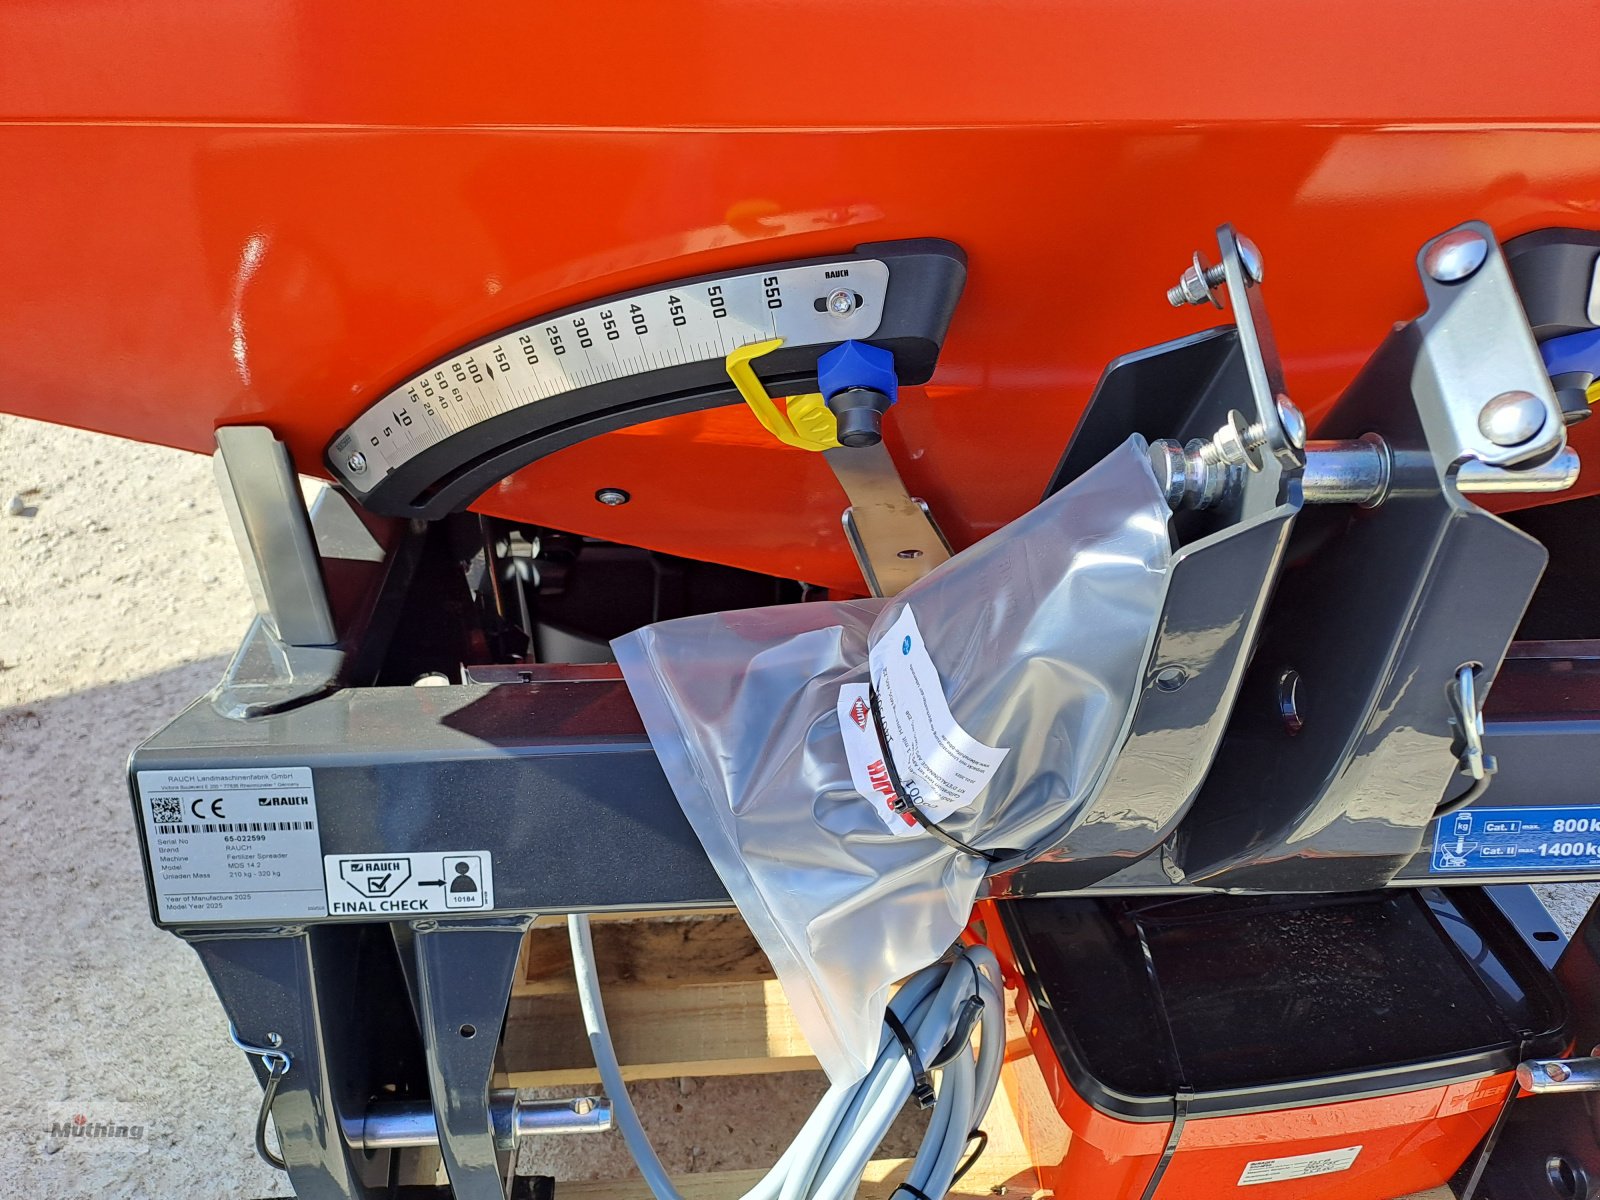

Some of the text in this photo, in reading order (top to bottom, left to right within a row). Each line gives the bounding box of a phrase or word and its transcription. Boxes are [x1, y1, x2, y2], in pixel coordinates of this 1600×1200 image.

[825, 269, 849, 279] RAUCH
[763, 275, 783, 310] 550
[667, 294, 687, 327] 450
[707, 285, 727, 319] 500
[599, 309, 620, 341] 350
[629, 303, 649, 336] 400
[545, 325, 566, 356] 250
[572, 317, 593, 349] 300
[492, 344, 511, 373] 150
[518, 334, 539, 366] 200
[451, 362, 467, 383] 80
[464, 356, 484, 384] 100
[419, 379, 435, 398] 30
[434, 371, 449, 391] 50
[406, 387, 420, 404] 15
[438, 395, 449, 410] 40
[451, 388, 464, 403] 60
[398, 407, 413, 427] 10
[423, 402, 435, 417] 20
[382, 426, 393, 438] 5
[370, 436, 380, 447] 0
[856, 701, 866, 727] KUHN
[168, 775, 195, 783] RAUCH
[272, 796, 309, 806] RAUCH
[1457, 822, 1470, 832] kg
[1486, 823, 1508, 832] Cat.
[224, 834, 266, 842] 65-022599
[1482, 846, 1504, 855] Cat.
[365, 861, 401, 871] RAUCH
[333, 901, 377, 913] FINAL
[380, 900, 429, 911] CHECK
